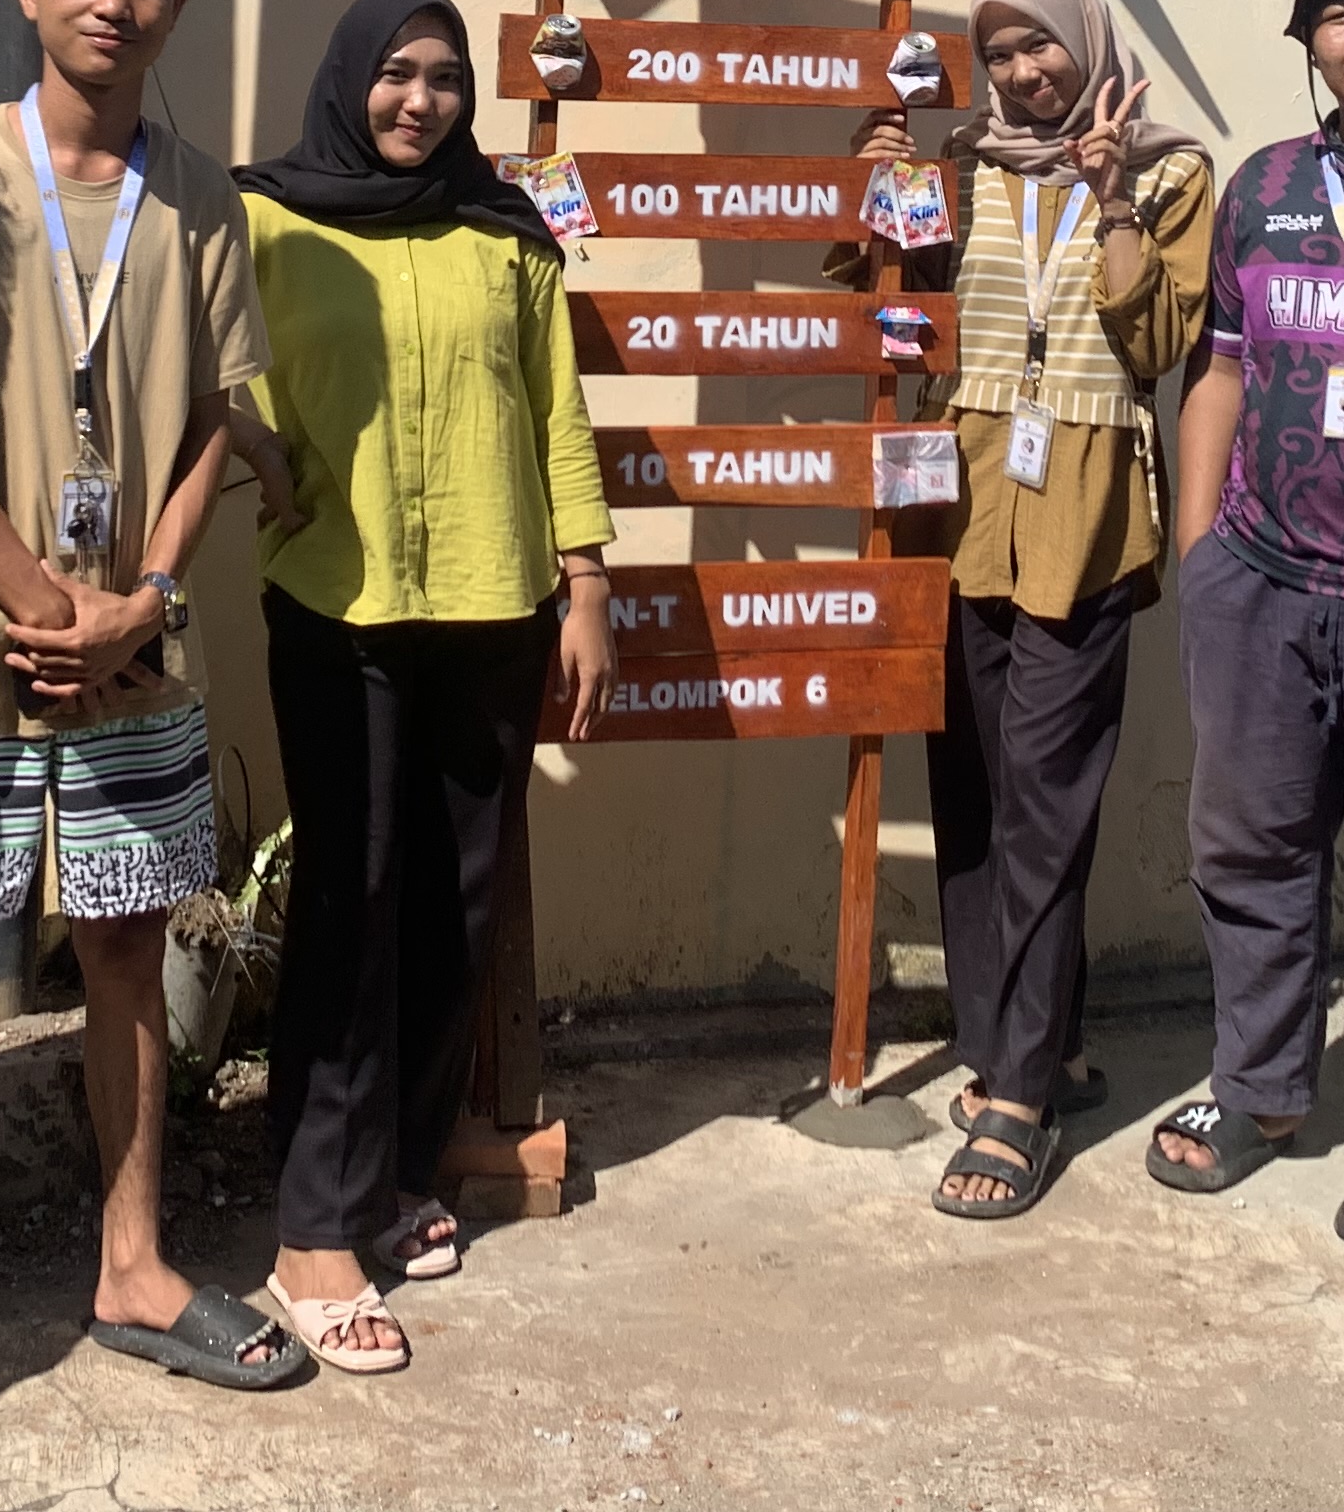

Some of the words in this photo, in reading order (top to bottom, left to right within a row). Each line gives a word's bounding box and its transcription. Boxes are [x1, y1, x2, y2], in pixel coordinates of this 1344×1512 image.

[626, 48, 701, 84] 200
[716, 51, 860, 90] TAHUN
[607, 183, 680, 216] 100
[694, 184, 838, 217] TAHUN
[627, 315, 677, 349] 20
[694, 316, 838, 349] TAHUN
[616, 452, 666, 486] 10
[687, 450, 832, 485] TAHUN
[557, 594, 678, 629] N-T
[721, 591, 878, 628] UNIVED
[607, 676, 783, 713] ELOMPOK
[805, 674, 829, 706] 6
